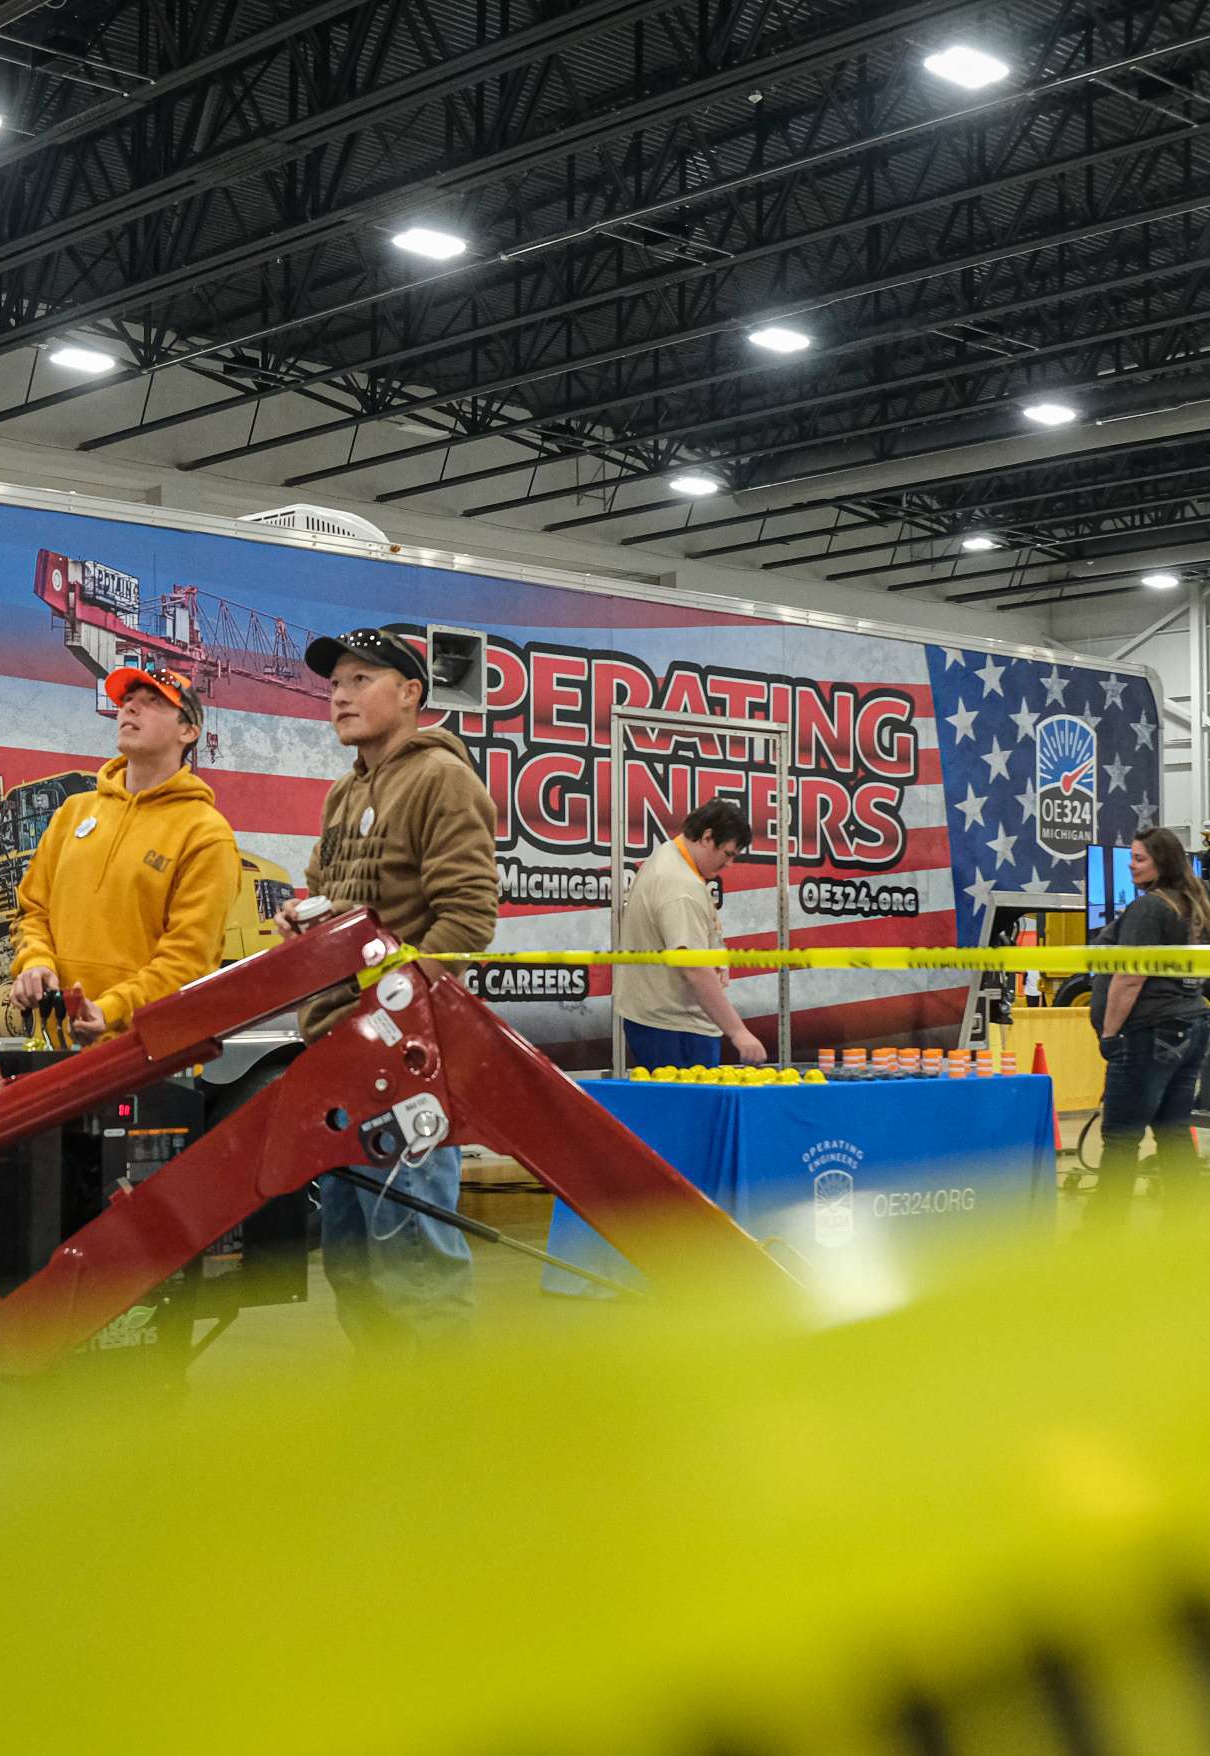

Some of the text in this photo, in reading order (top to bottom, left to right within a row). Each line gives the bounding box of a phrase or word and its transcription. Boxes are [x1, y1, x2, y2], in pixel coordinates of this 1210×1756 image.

[398, 633, 916, 778] PERATING
[476, 747, 904, 864] GINERS
[1041, 798, 1092, 825] OE324
[1041, 828, 1092, 842] MICHIGAN
[143, 849, 173, 873] CAT
[485, 968, 586, 996] CAREERS
[802, 1139, 865, 1163] OPERATING
[808, 1152, 859, 1173] ENGINEERS
[873, 1187, 975, 1218] OE324.ORG
